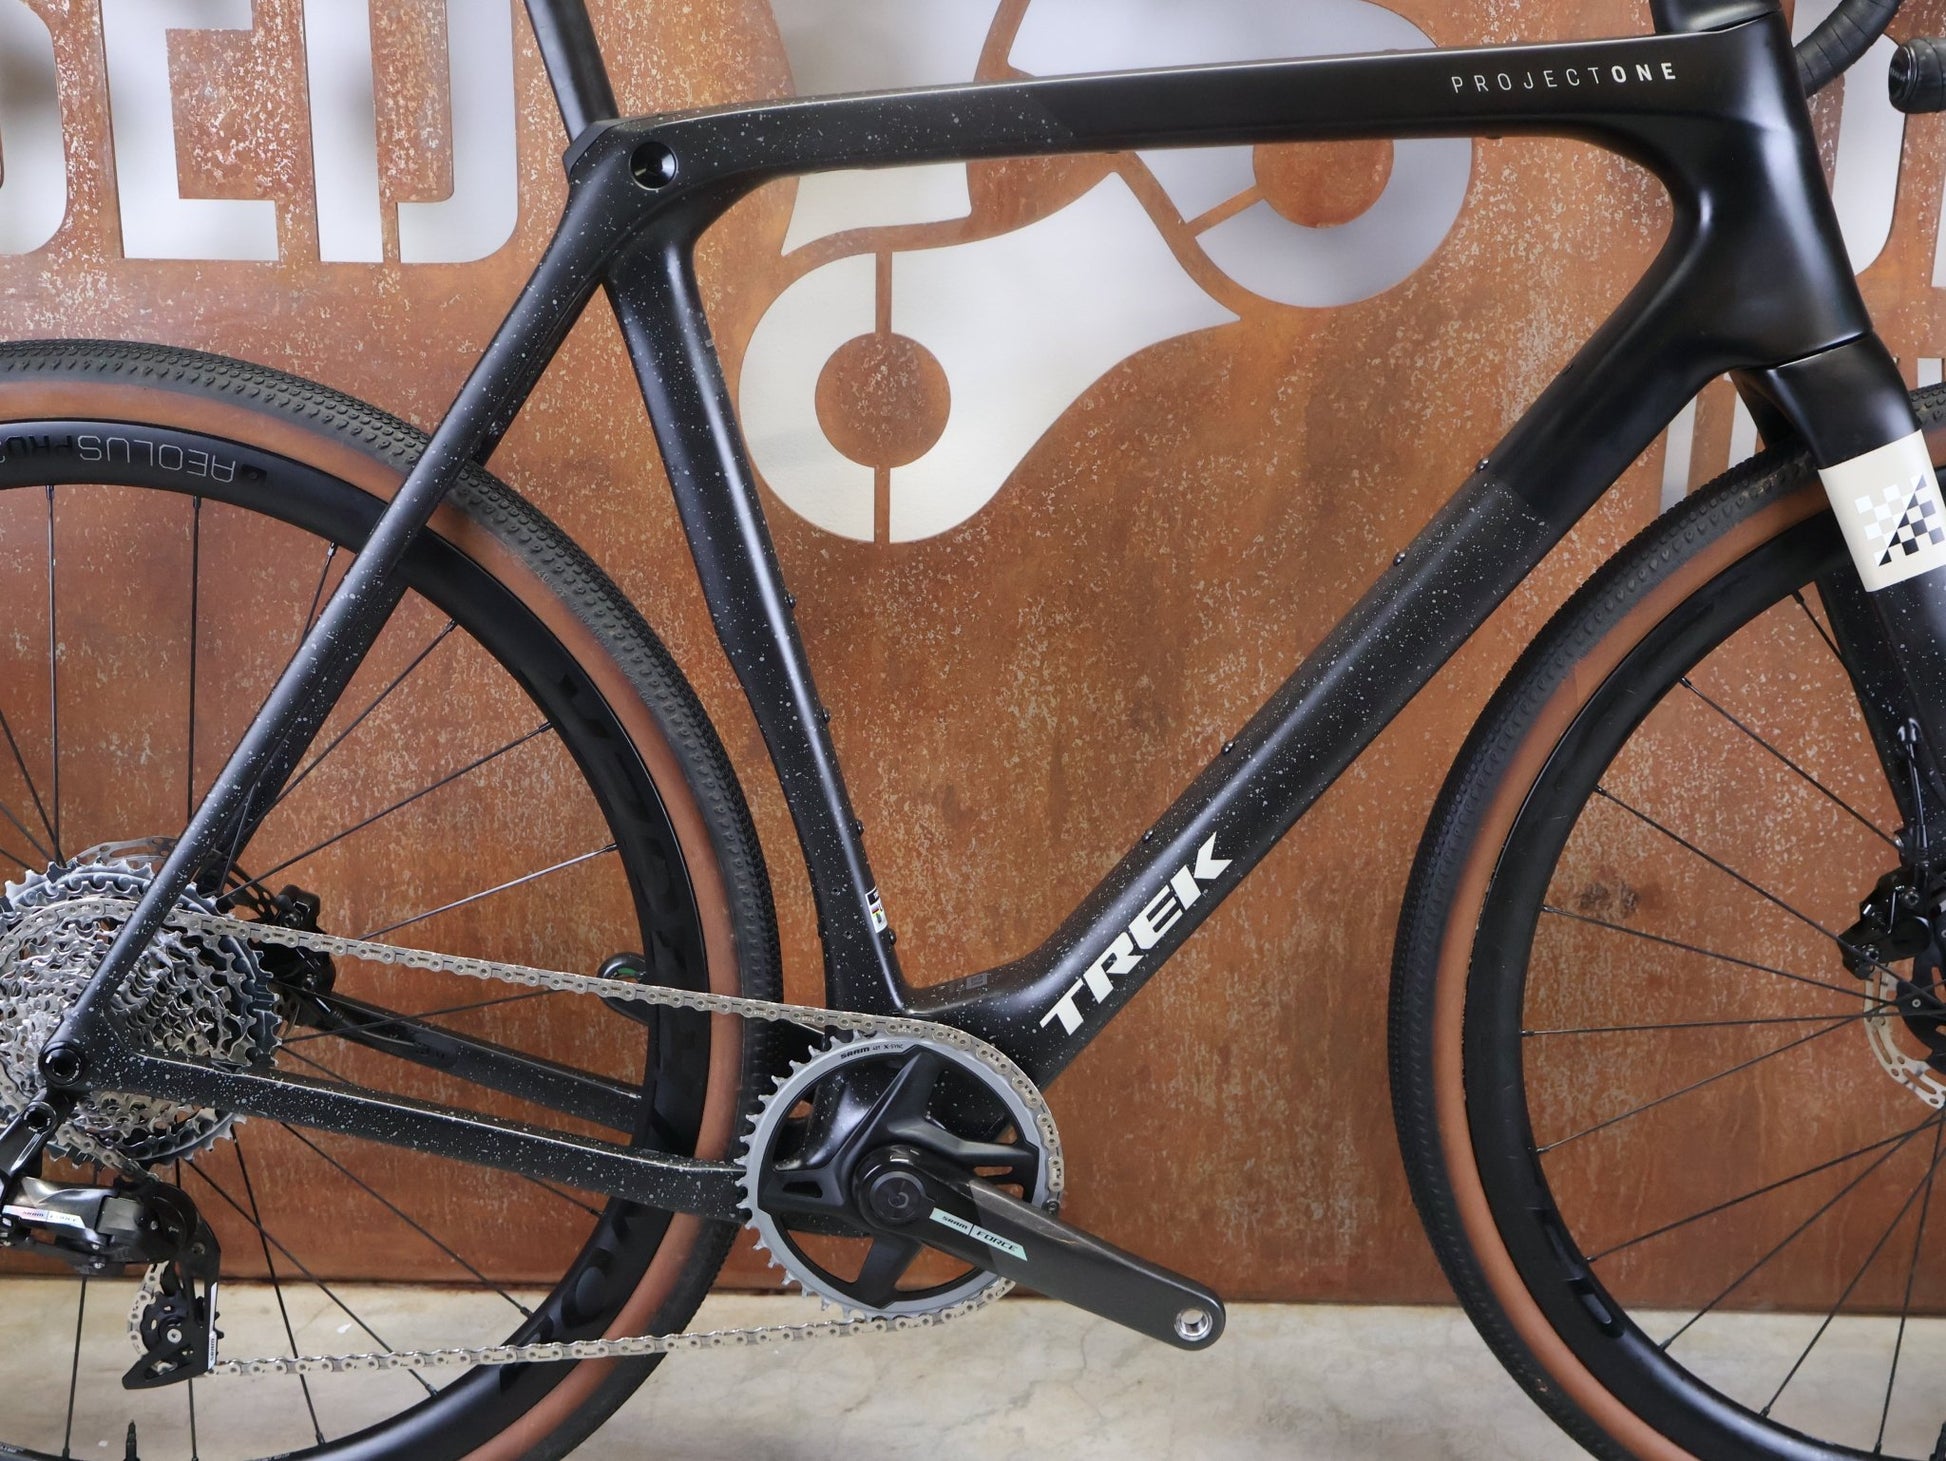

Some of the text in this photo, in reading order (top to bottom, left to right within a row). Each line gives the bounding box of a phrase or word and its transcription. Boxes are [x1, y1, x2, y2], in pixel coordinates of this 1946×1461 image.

[77, 435, 236, 483] AEOLUS
[1039, 831, 1233, 1036] TREK
[840, 1046, 870, 1059] SRAM
[942, 1215, 1018, 1252] SRAM FORCE
